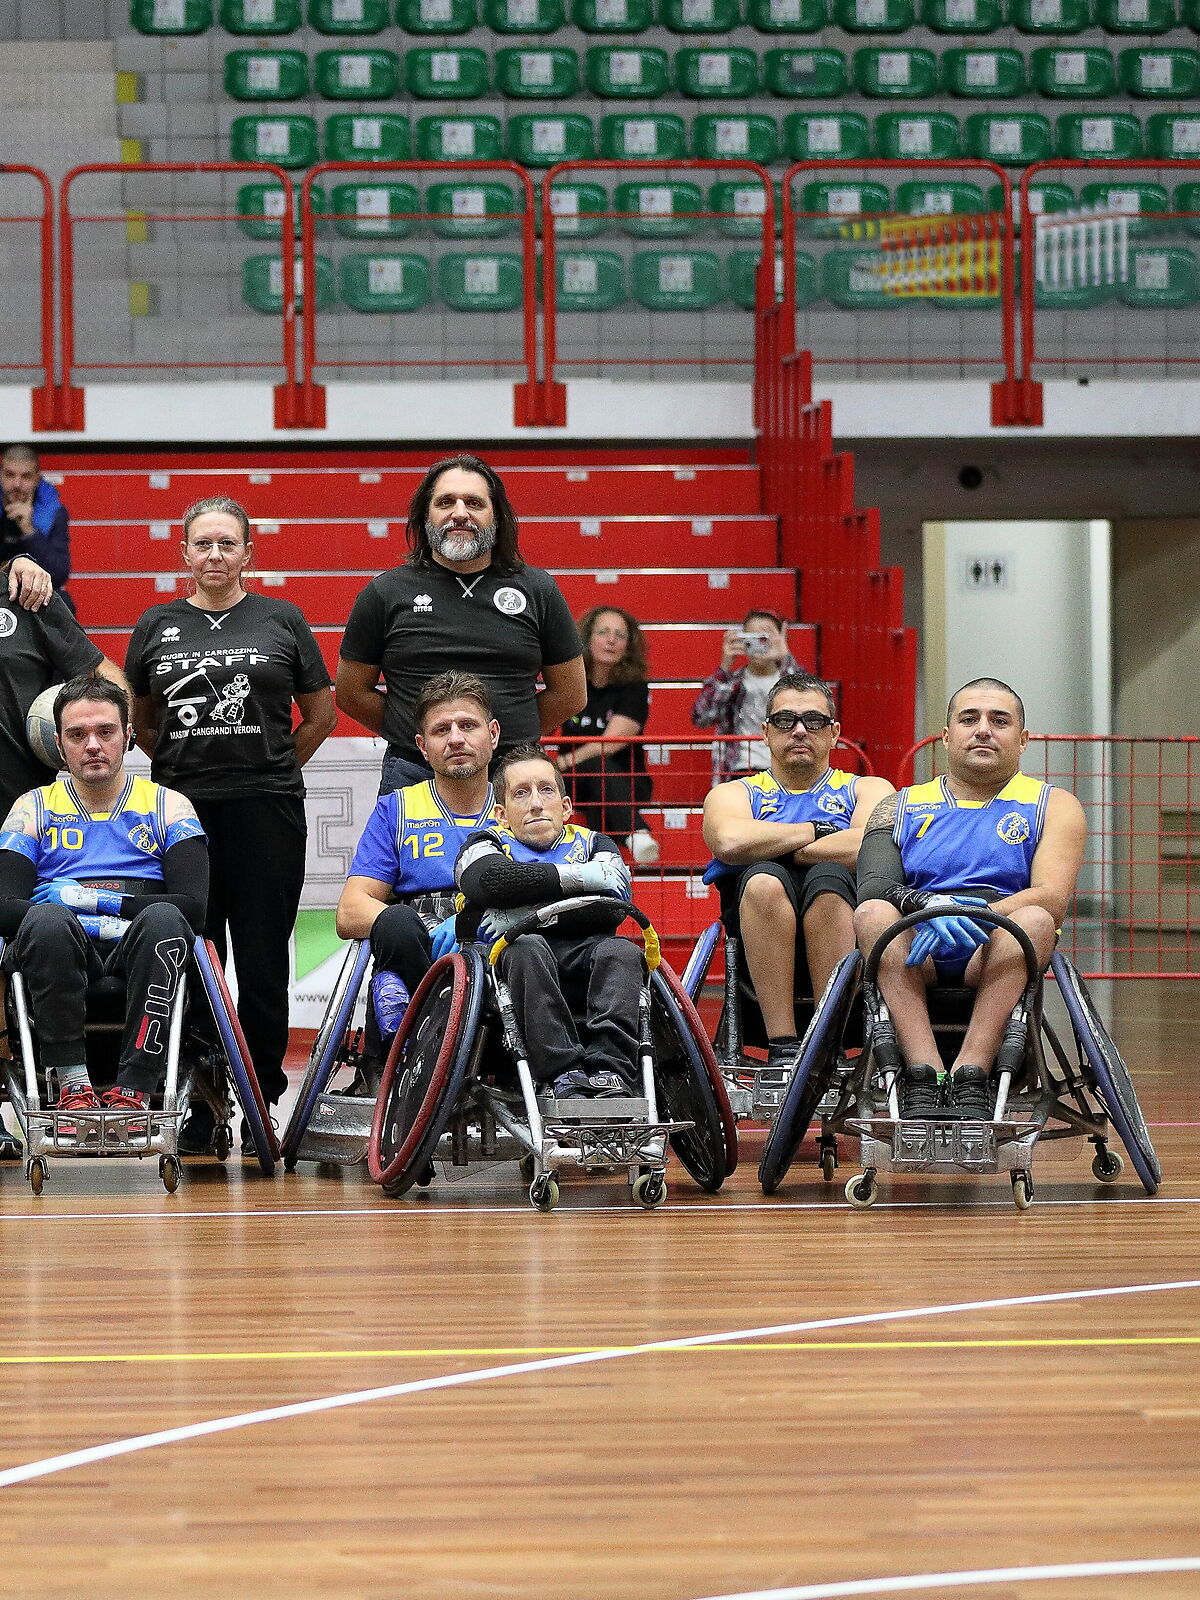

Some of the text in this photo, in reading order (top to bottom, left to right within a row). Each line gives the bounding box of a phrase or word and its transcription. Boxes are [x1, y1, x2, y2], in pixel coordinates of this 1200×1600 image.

[155, 654, 270, 675] STAFF
[160, 651, 189, 661] RUGBY
[204, 647, 259, 657] CARROZZINA
[191, 726, 232, 735] CANGRANDI
[233, 725, 261, 735] VERONA
[905, 804, 942, 812] macron
[406, 821, 441, 829] macron
[913, 813, 935, 839] 7
[45, 826, 84, 850] 10
[403, 832, 445, 859] 12
[135, 936, 188, 1055] FILA
